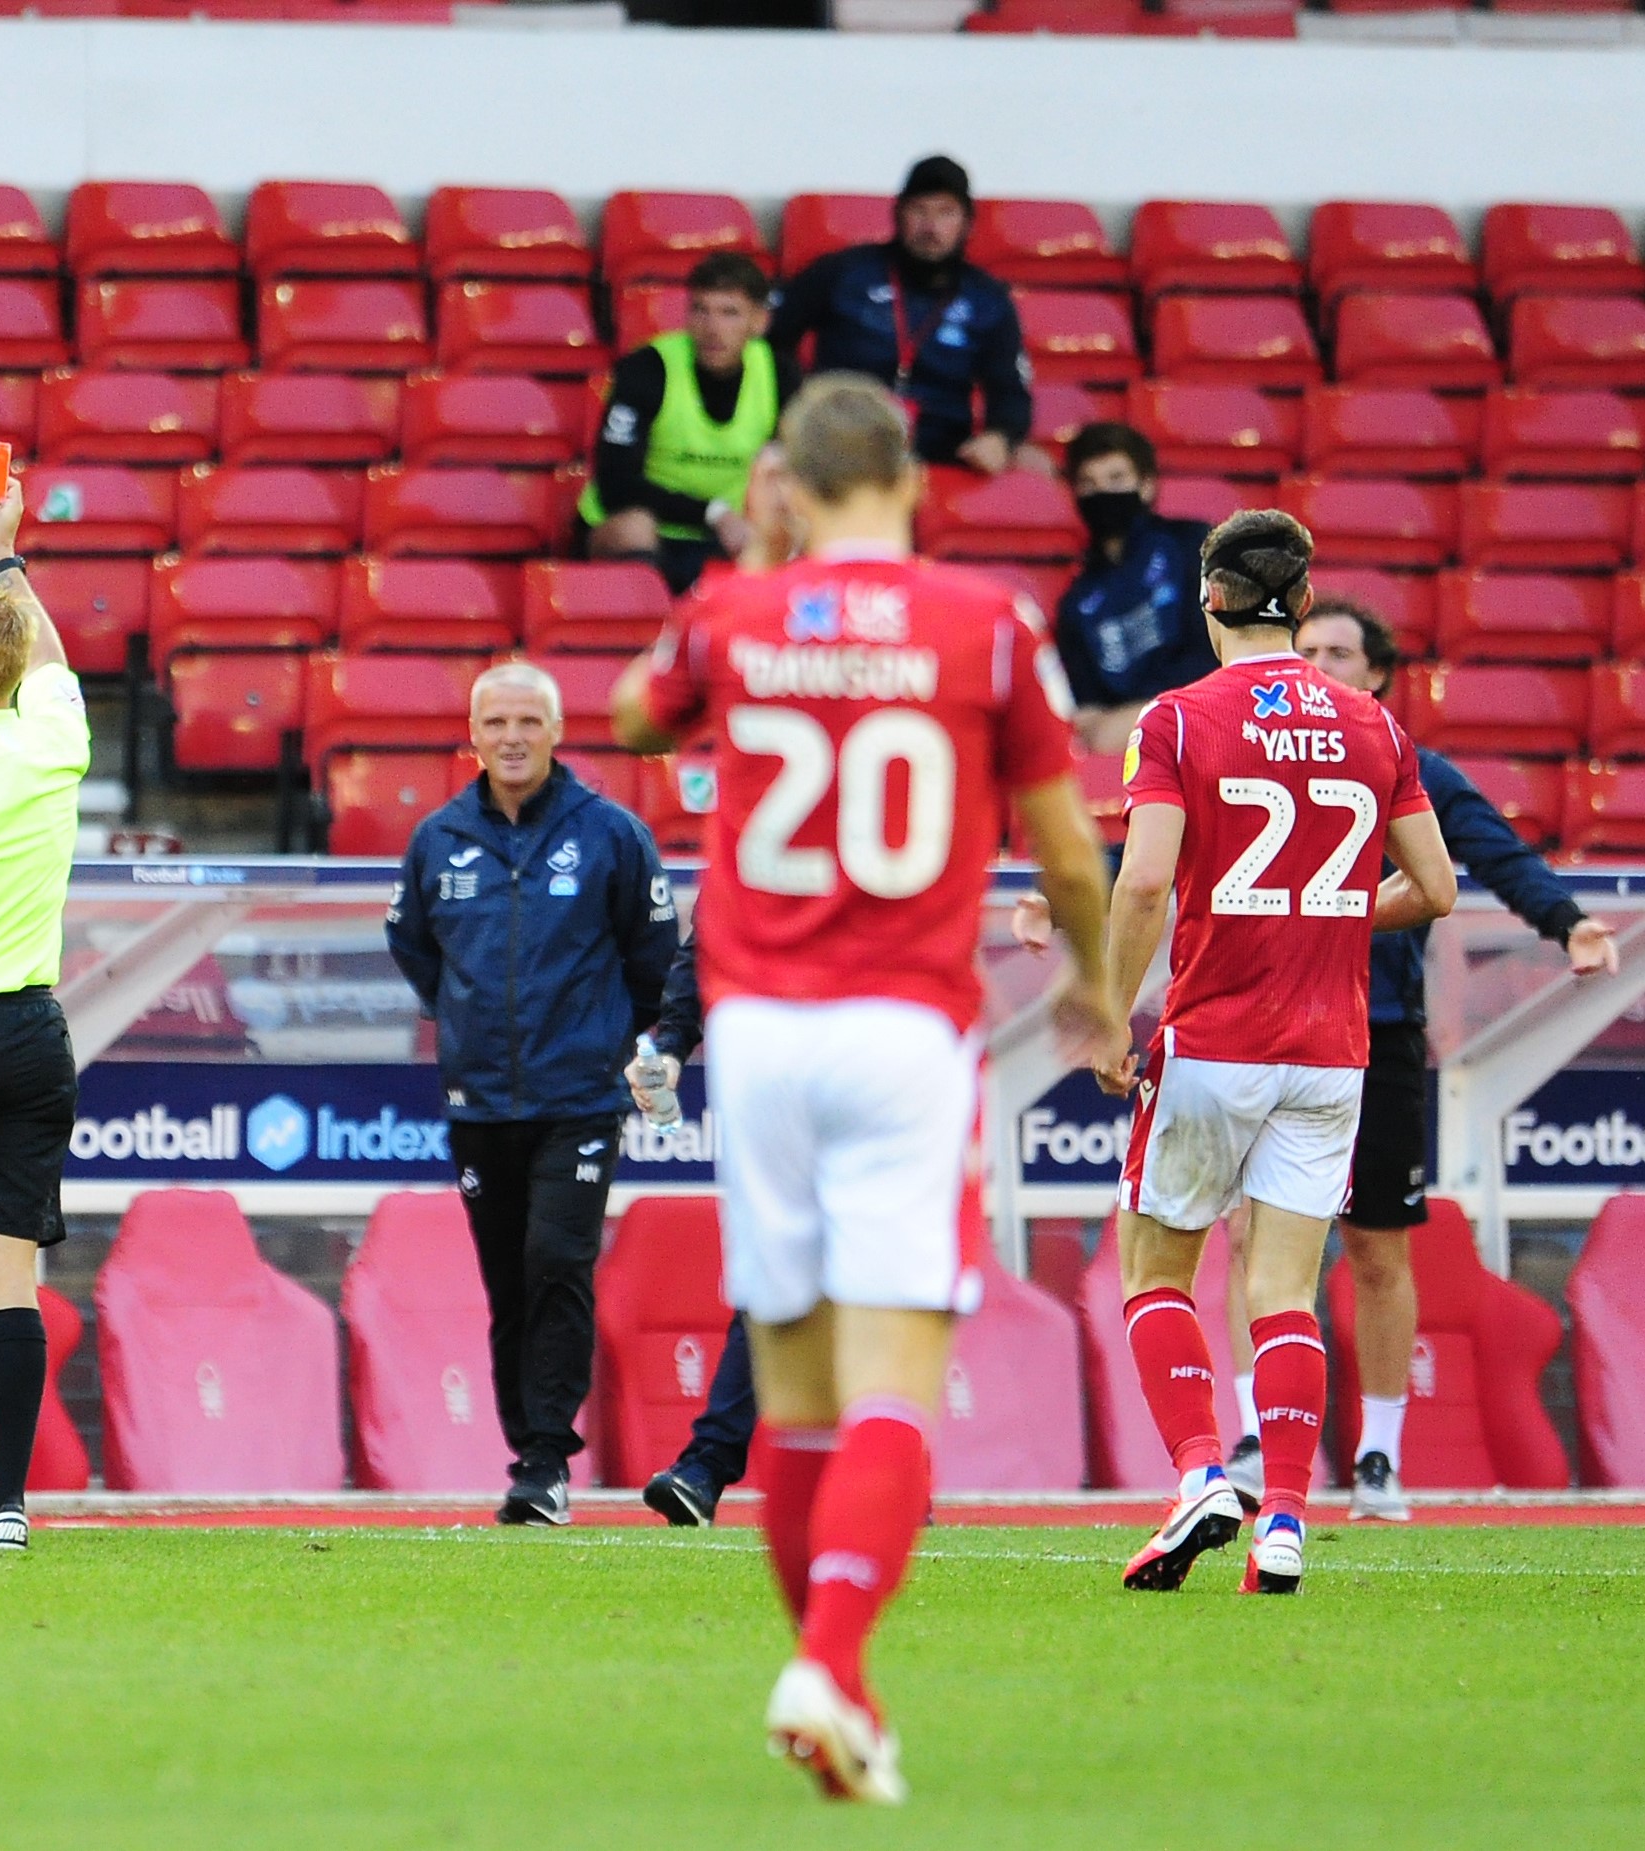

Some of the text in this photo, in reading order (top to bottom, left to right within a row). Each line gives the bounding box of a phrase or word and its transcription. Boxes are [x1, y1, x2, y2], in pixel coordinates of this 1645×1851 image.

[1295, 681, 1333, 706] UK
[1300, 701, 1338, 718] Meds
[1256, 728, 1346, 763] YATES
[726, 704, 957, 899] 20
[1211, 777, 1377, 917] 22
[132, 866, 186, 883] Football
[69, 1104, 449, 1160] ootball Index
[1506, 1110, 1645, 1166] Footb
[1170, 1366, 1215, 1384] NFF
